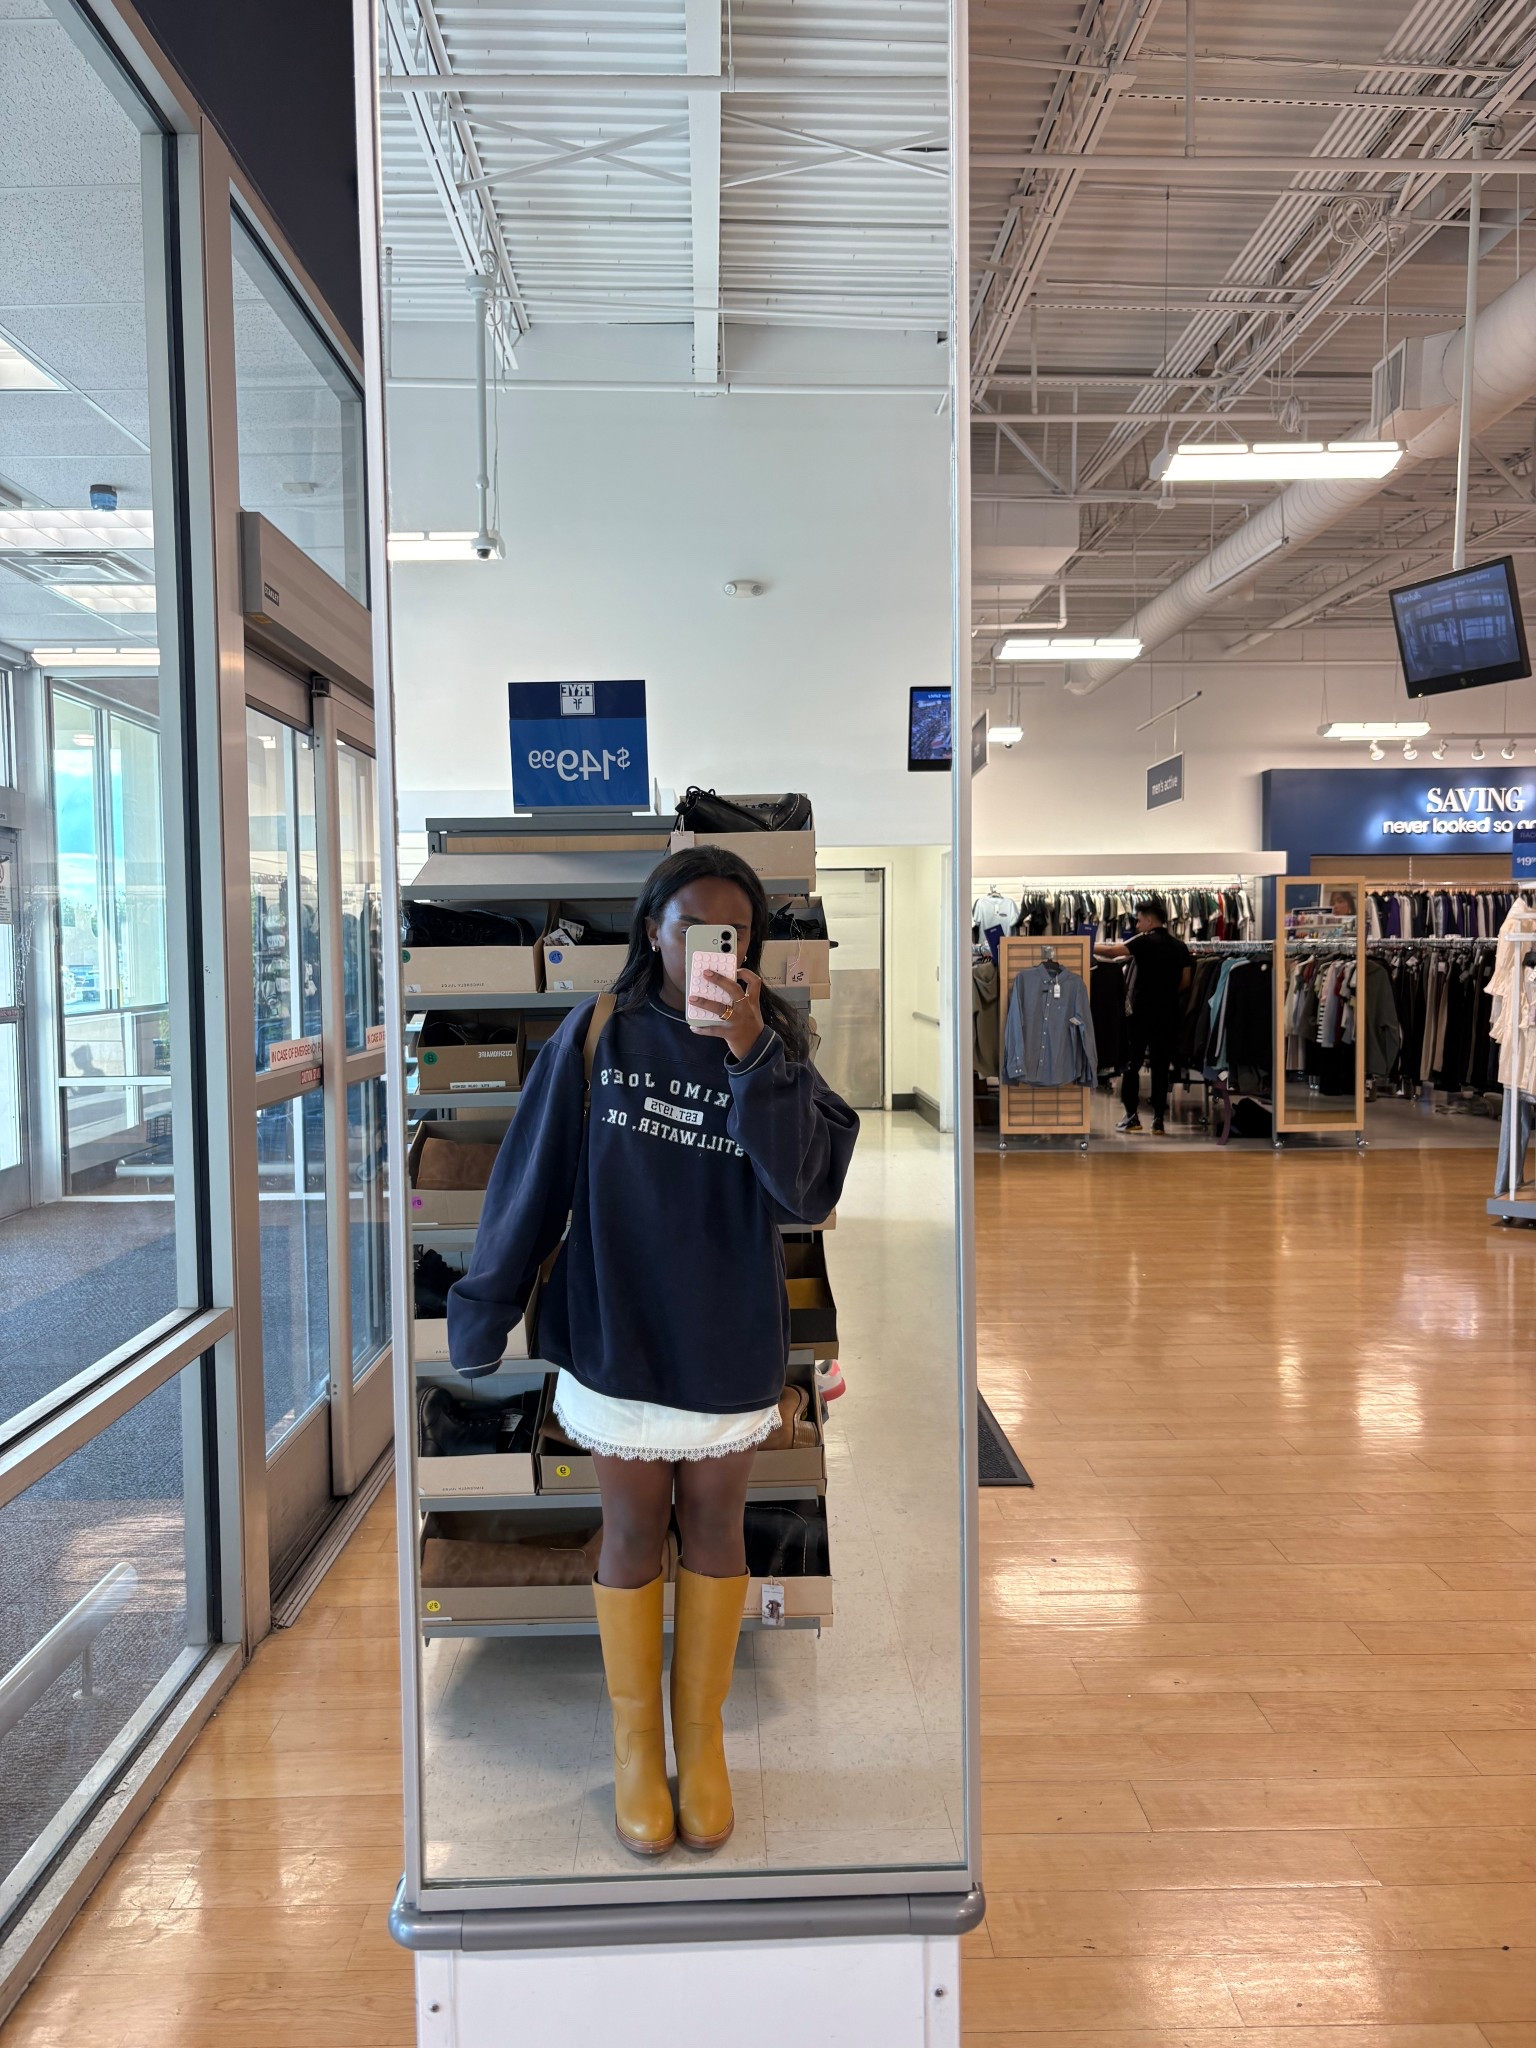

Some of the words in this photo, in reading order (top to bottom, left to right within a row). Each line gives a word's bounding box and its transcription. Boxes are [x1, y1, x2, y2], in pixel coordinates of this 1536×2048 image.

[1426, 786, 1526, 813] SAVING
[1382, 819, 1430, 835] never
[1432, 816, 1490, 834] looked
[1493, 820, 1513, 834] so
[271, 1050, 277, 1063] IN
[277, 1048, 288, 1061] CASE
[288, 1047, 294, 1060] OF
